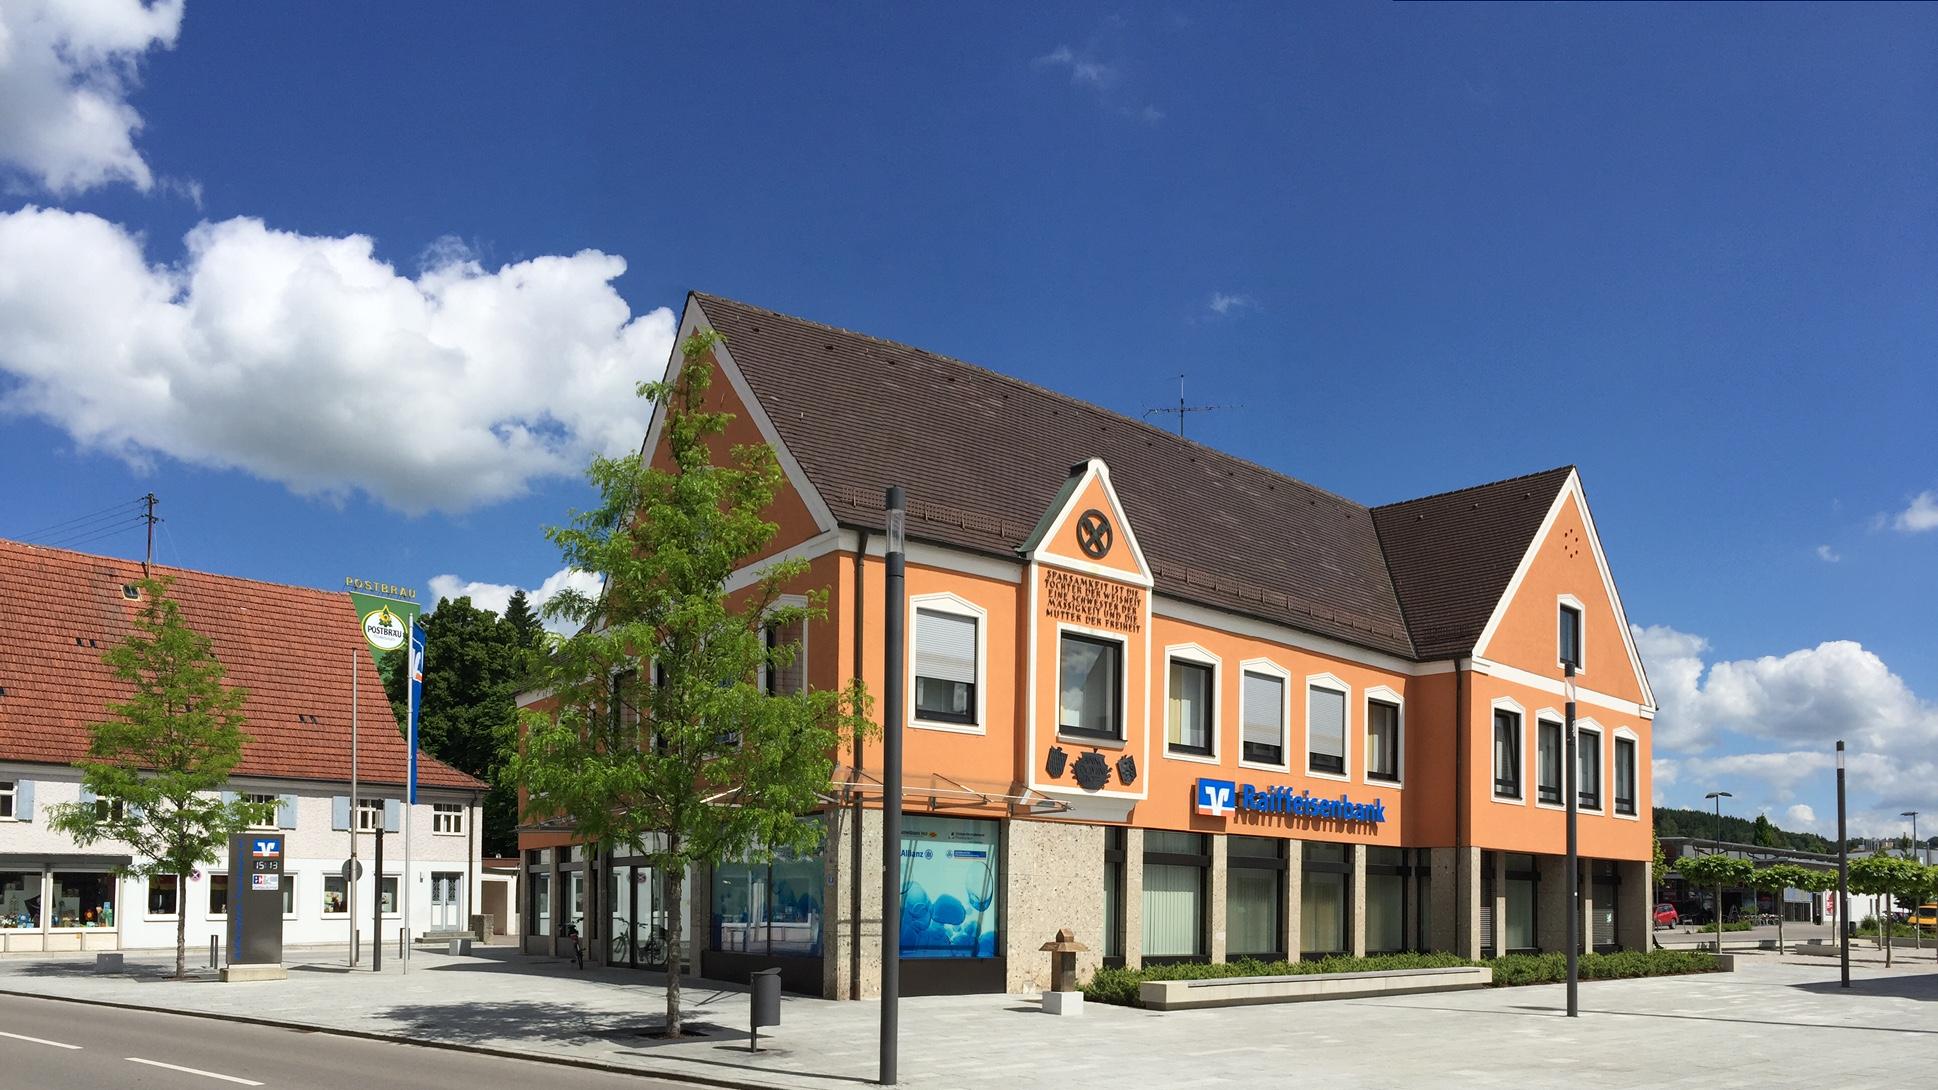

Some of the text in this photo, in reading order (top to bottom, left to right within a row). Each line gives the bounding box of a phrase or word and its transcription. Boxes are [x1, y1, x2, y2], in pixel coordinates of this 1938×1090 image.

[1046, 608, 1081, 621] MUTTER
[1105, 619, 1140, 634] FREIHEIT
[1241, 784, 1386, 823] Raiffeisenbank
[900, 849, 924, 858] Allianz
